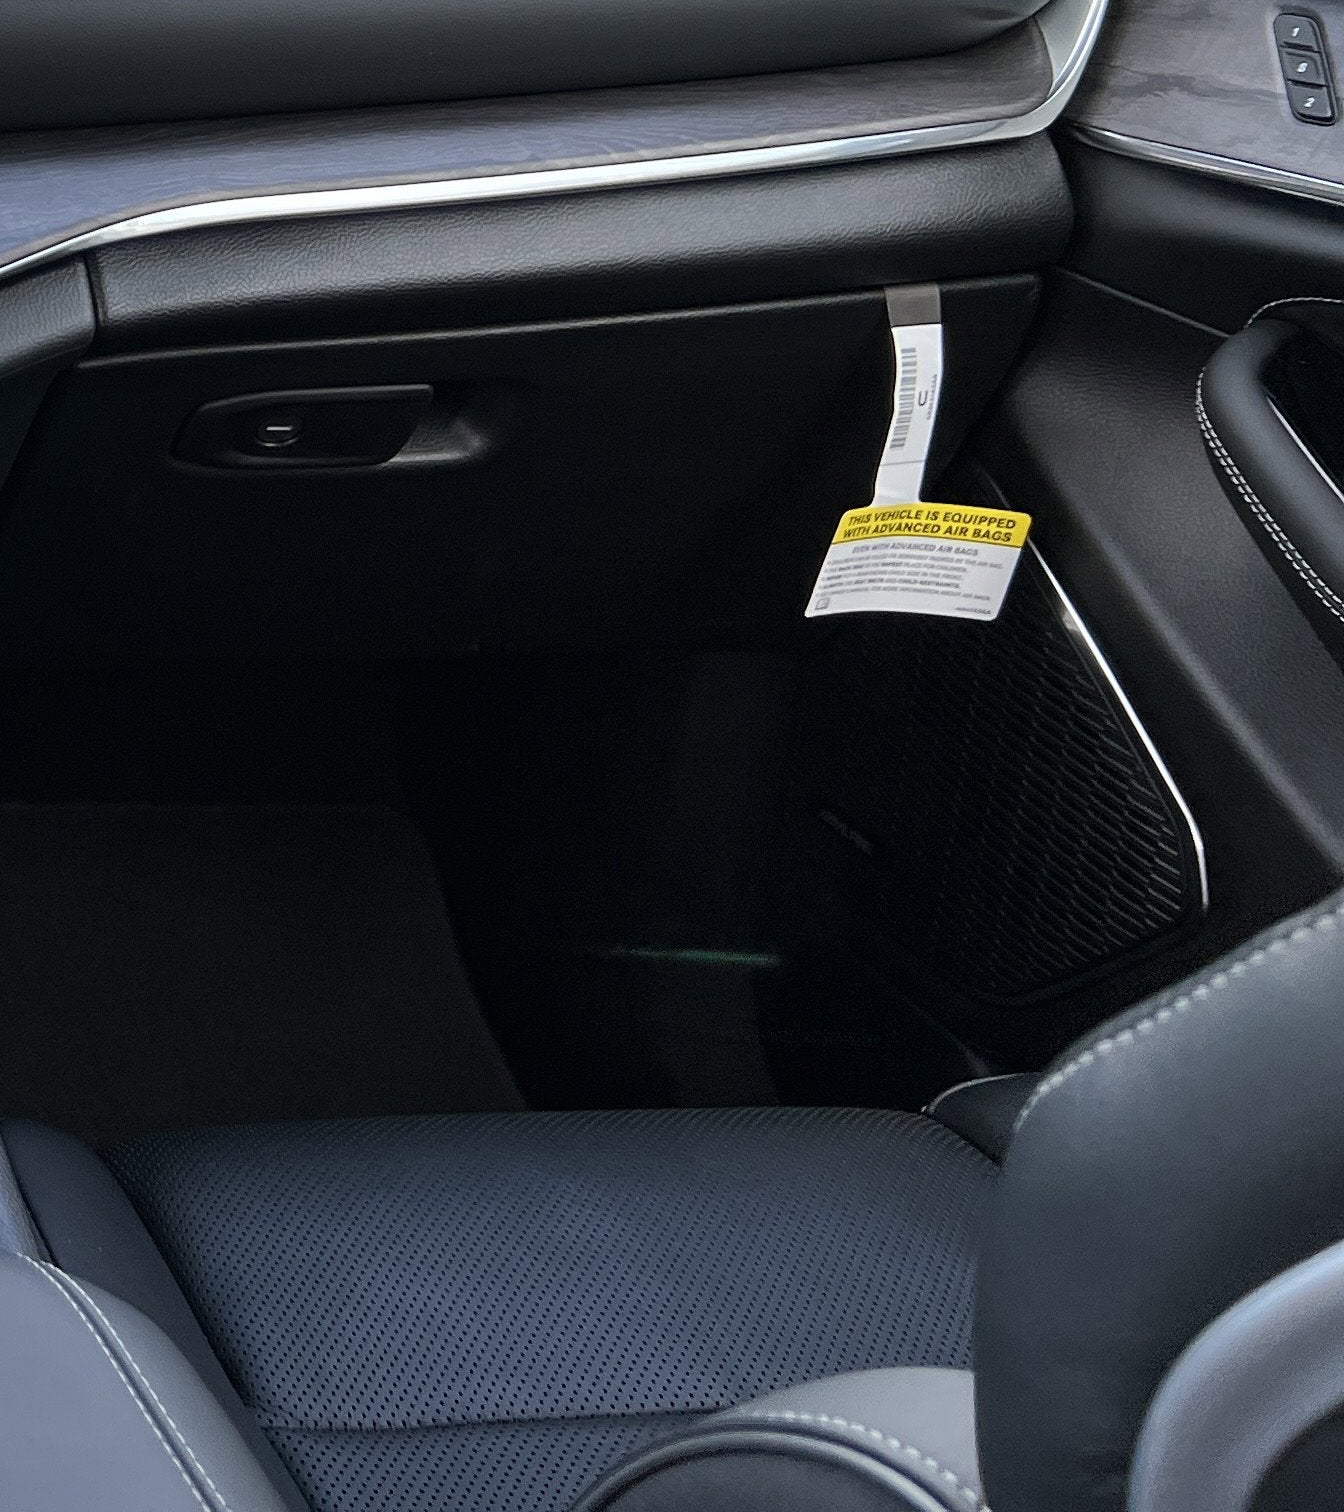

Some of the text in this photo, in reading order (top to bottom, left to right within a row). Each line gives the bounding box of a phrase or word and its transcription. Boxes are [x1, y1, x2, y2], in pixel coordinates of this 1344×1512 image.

[1291, 26, 1301, 38] 1
[1303, 96, 1315, 108] 2
[847, 510, 1017, 529] THIS VEHICLE IS EQUIPPED
[843, 522, 1013, 543] WITH ADVANCED AIR BAGS
[890, 542, 936, 553] ADVANCED
[938, 544, 953, 554] AIR
